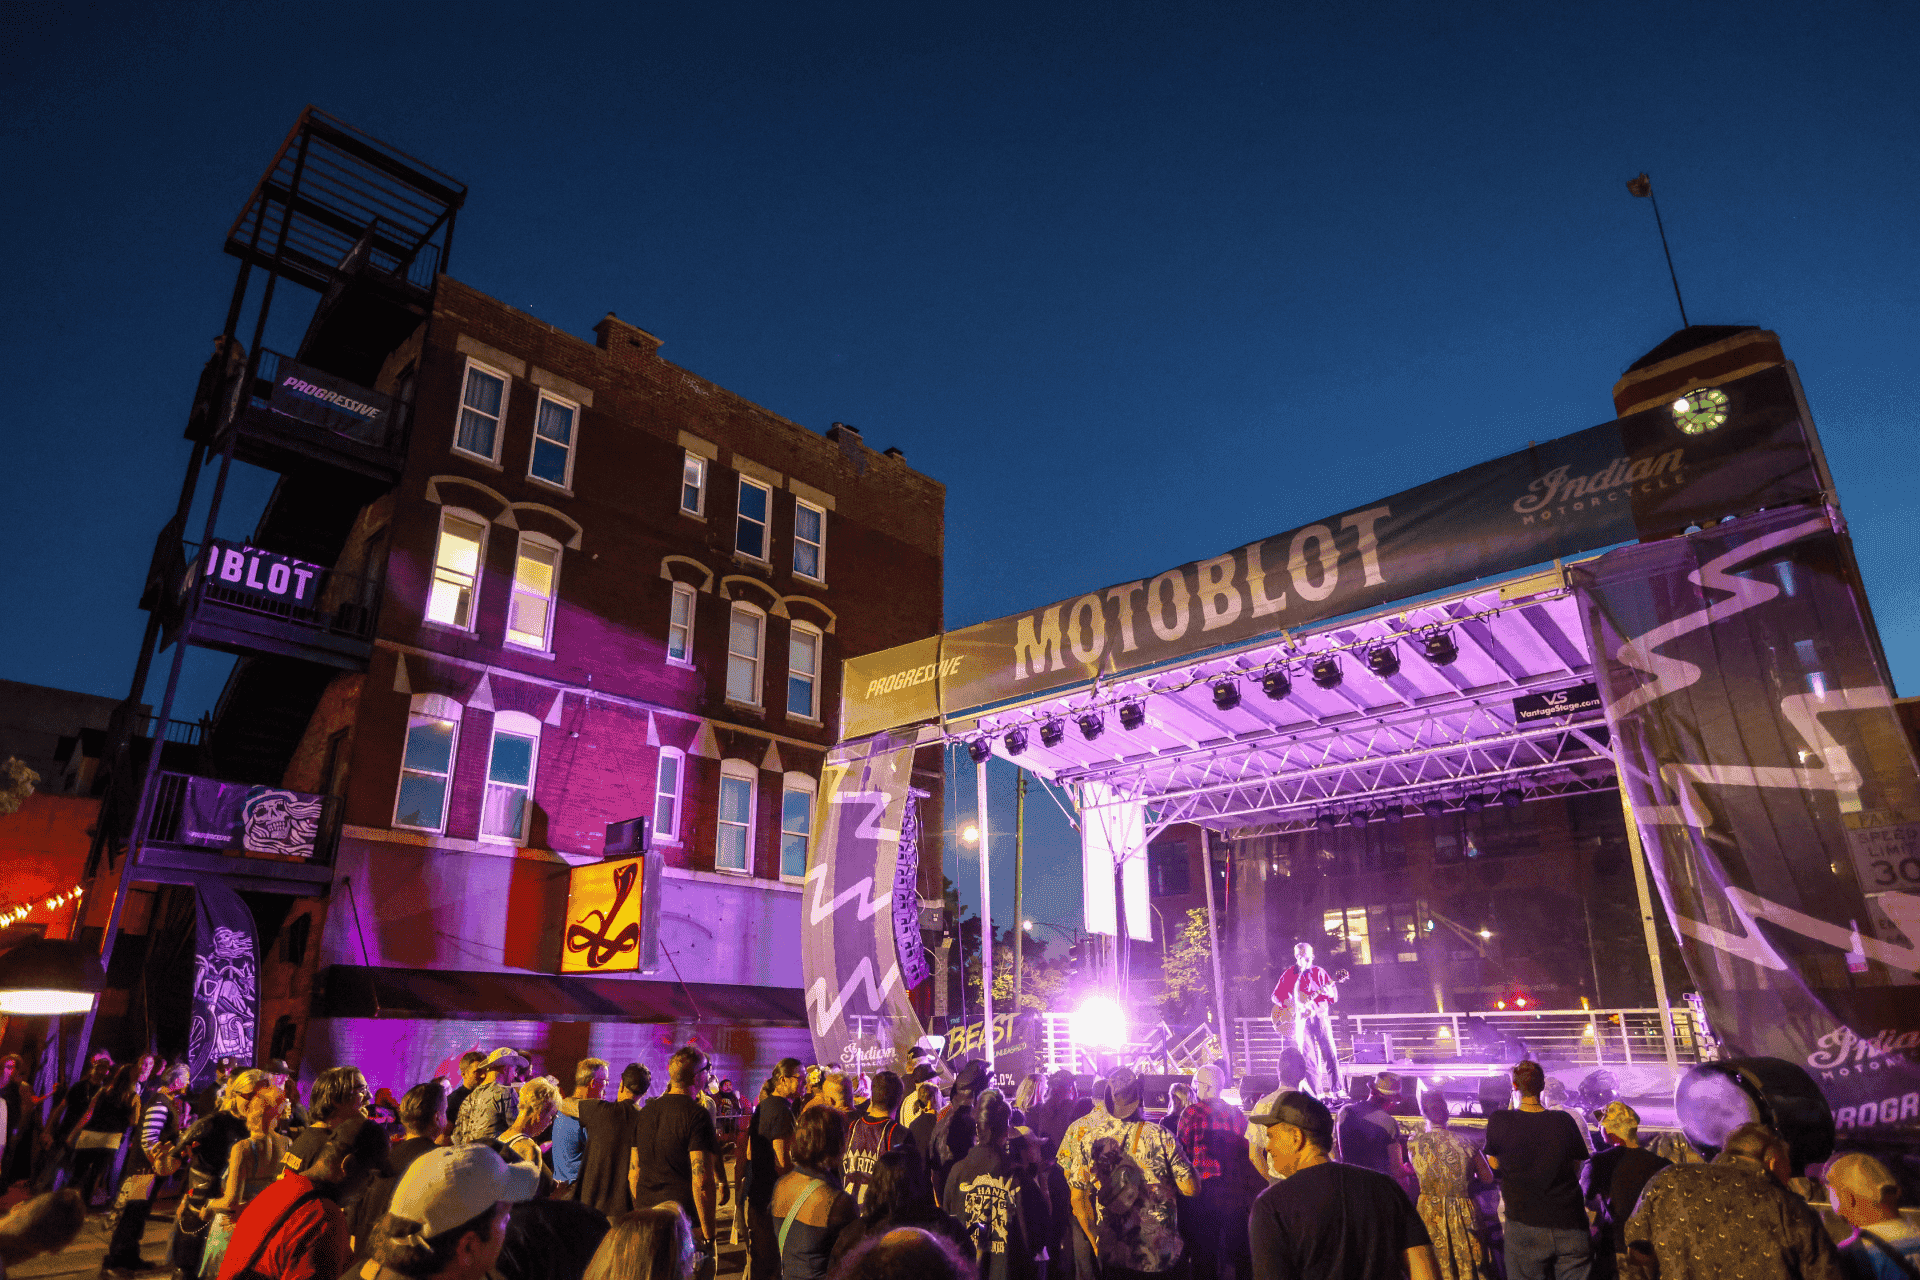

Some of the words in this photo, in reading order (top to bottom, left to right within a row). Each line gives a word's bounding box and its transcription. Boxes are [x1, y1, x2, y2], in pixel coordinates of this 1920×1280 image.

[283, 376, 381, 418] PROGRESSIVE
[1513, 449, 1685, 514] Indian
[1523, 473, 1685, 525] MOTORCYCLE
[1014, 505, 1391, 681] MOTOBLOT
[865, 655, 966, 699] PROGRESSIVE
[1520, 699, 1600, 718] VantageStage.com
[1542, 691, 1568, 706] VS
[1871, 858, 1920, 885] 30
[840, 1042, 897, 1063] Indian
[1831, 1092, 1919, 1130] ROGR
[977, 1186, 1006, 1200] HANK
